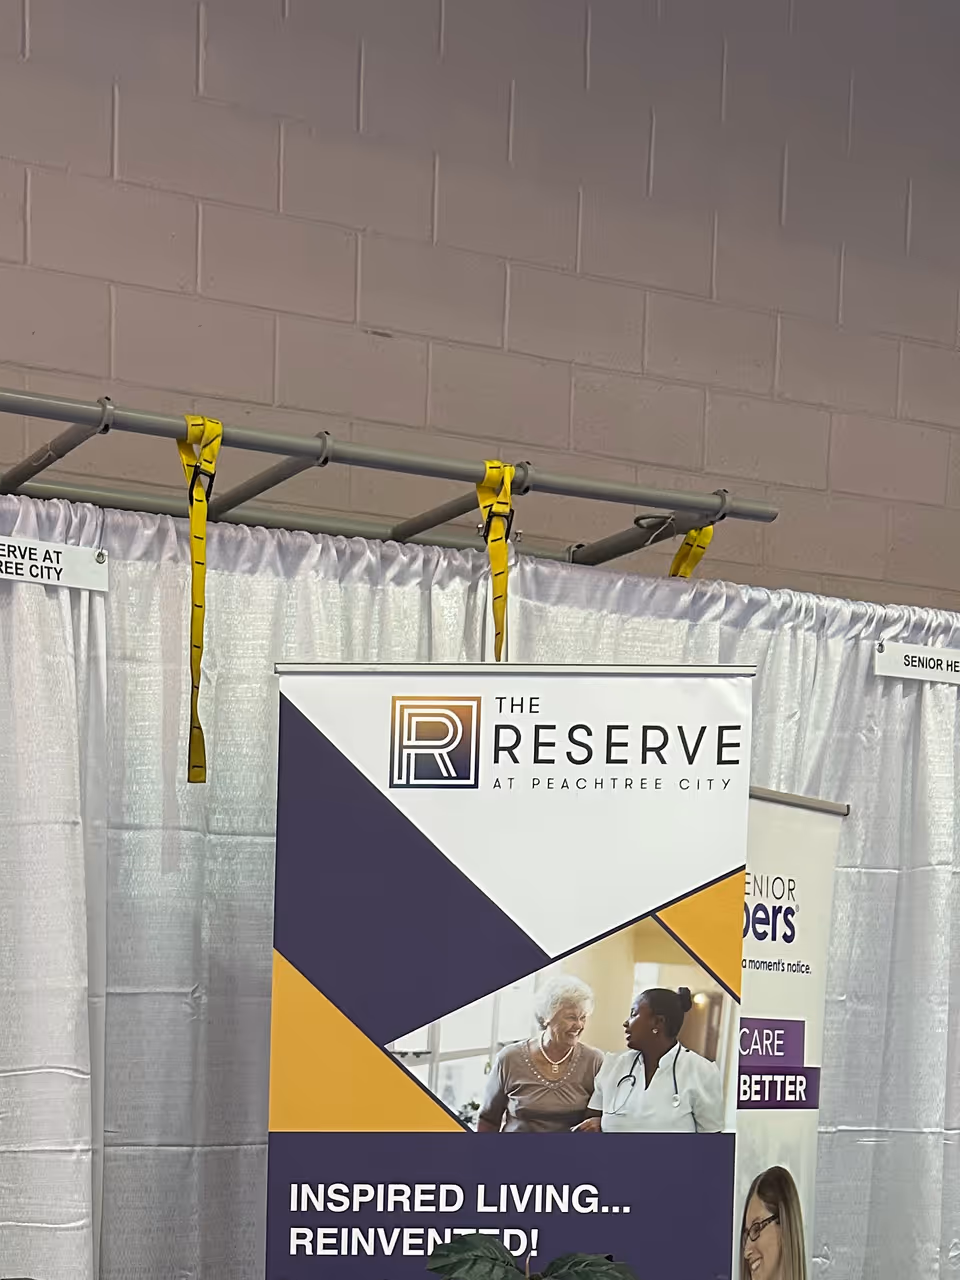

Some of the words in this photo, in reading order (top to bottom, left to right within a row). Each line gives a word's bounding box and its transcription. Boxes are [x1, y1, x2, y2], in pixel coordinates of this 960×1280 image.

[42, 549, 62, 565] AT
[28, 563, 64, 581] CITY
[903, 654, 943, 671] SENIOR
[495, 696, 541, 714] THE
[492, 723, 742, 766] RESERVE
[492, 778, 515, 791] AT
[531, 777, 663, 791] PEACHTREE
[678, 777, 732, 791] CITY
[744, 872, 797, 902] ENIOR
[749, 958, 785, 973] moment's
[786, 960, 812, 975] notice.
[739, 1027, 785, 1057] CARE
[740, 1074, 807, 1102] BETTER
[289, 1183, 465, 1213] INSPIRED
[476, 1183, 632, 1214] LIVING...
[289, 1227, 539, 1257] REINVEND!
